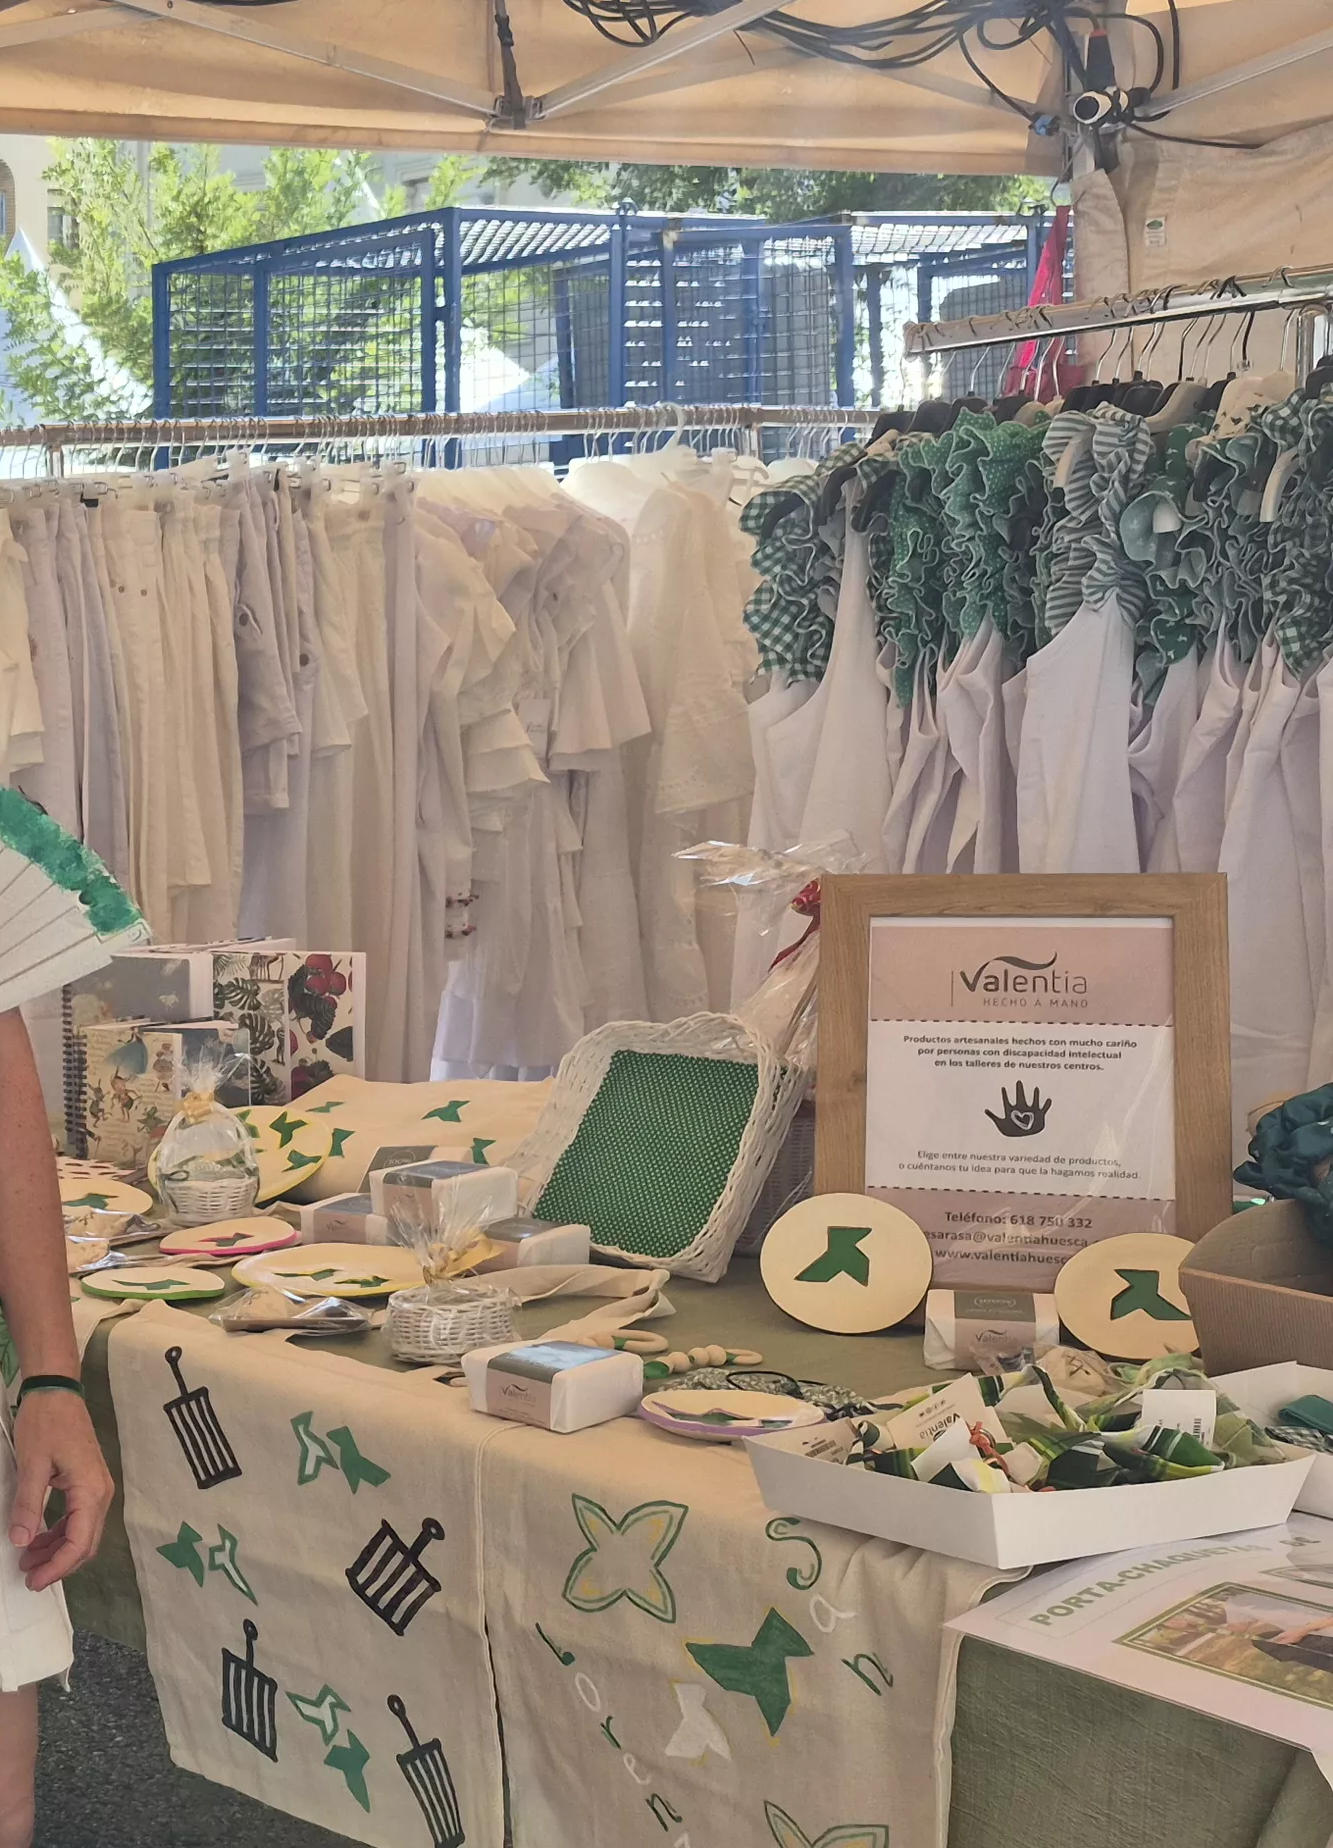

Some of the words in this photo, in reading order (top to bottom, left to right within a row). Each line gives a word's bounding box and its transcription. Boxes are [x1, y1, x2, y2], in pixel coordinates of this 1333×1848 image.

[959, 952, 1088, 995] Valentia
[983, 997, 1027, 1008] HECHO
[1034, 998, 1042, 1008] A
[1049, 998, 1089, 1009] MANO
[903, 1035, 952, 1045] Productos
[954, 1036, 1009, 1045] artesanales
[1012, 1037, 1047, 1046] hechos
[1048, 1039, 1067, 1047] con
[1069, 1038, 1103, 1048] mucho
[1106, 1039, 1138, 1049] cariño
[917, 1048, 935, 1057] por
[937, 1048, 981, 1058] personas
[1002, 1049, 1066, 1059] discapacidad
[1068, 1050, 1122, 1059] intelectual
[949, 1058, 963, 1068] los
[965, 1059, 1001, 1069] talleres
[1004, 1060, 1016, 1069] de
[1019, 1061, 1062, 1070] nuestros
[1064, 1062, 1104, 1071] centros.
[917, 1150, 940, 1161] Elige
[942, 1152, 968, 1161] entre
[970, 1153, 1007, 1163] nuestra
[1008, 1154, 1052, 1164] variedad
[1053, 1155, 1066, 1164] de
[1068, 1156, 1122, 1167] productos,
[944, 1211, 1007, 1225] Teléfono:
[1010, 1214, 1035, 1226] 618
[1068, 1217, 1093, 1229] 332
[935, 1250, 1067, 1265] www.valentiahuesc
[918, 1412, 962, 1441] Valentia
